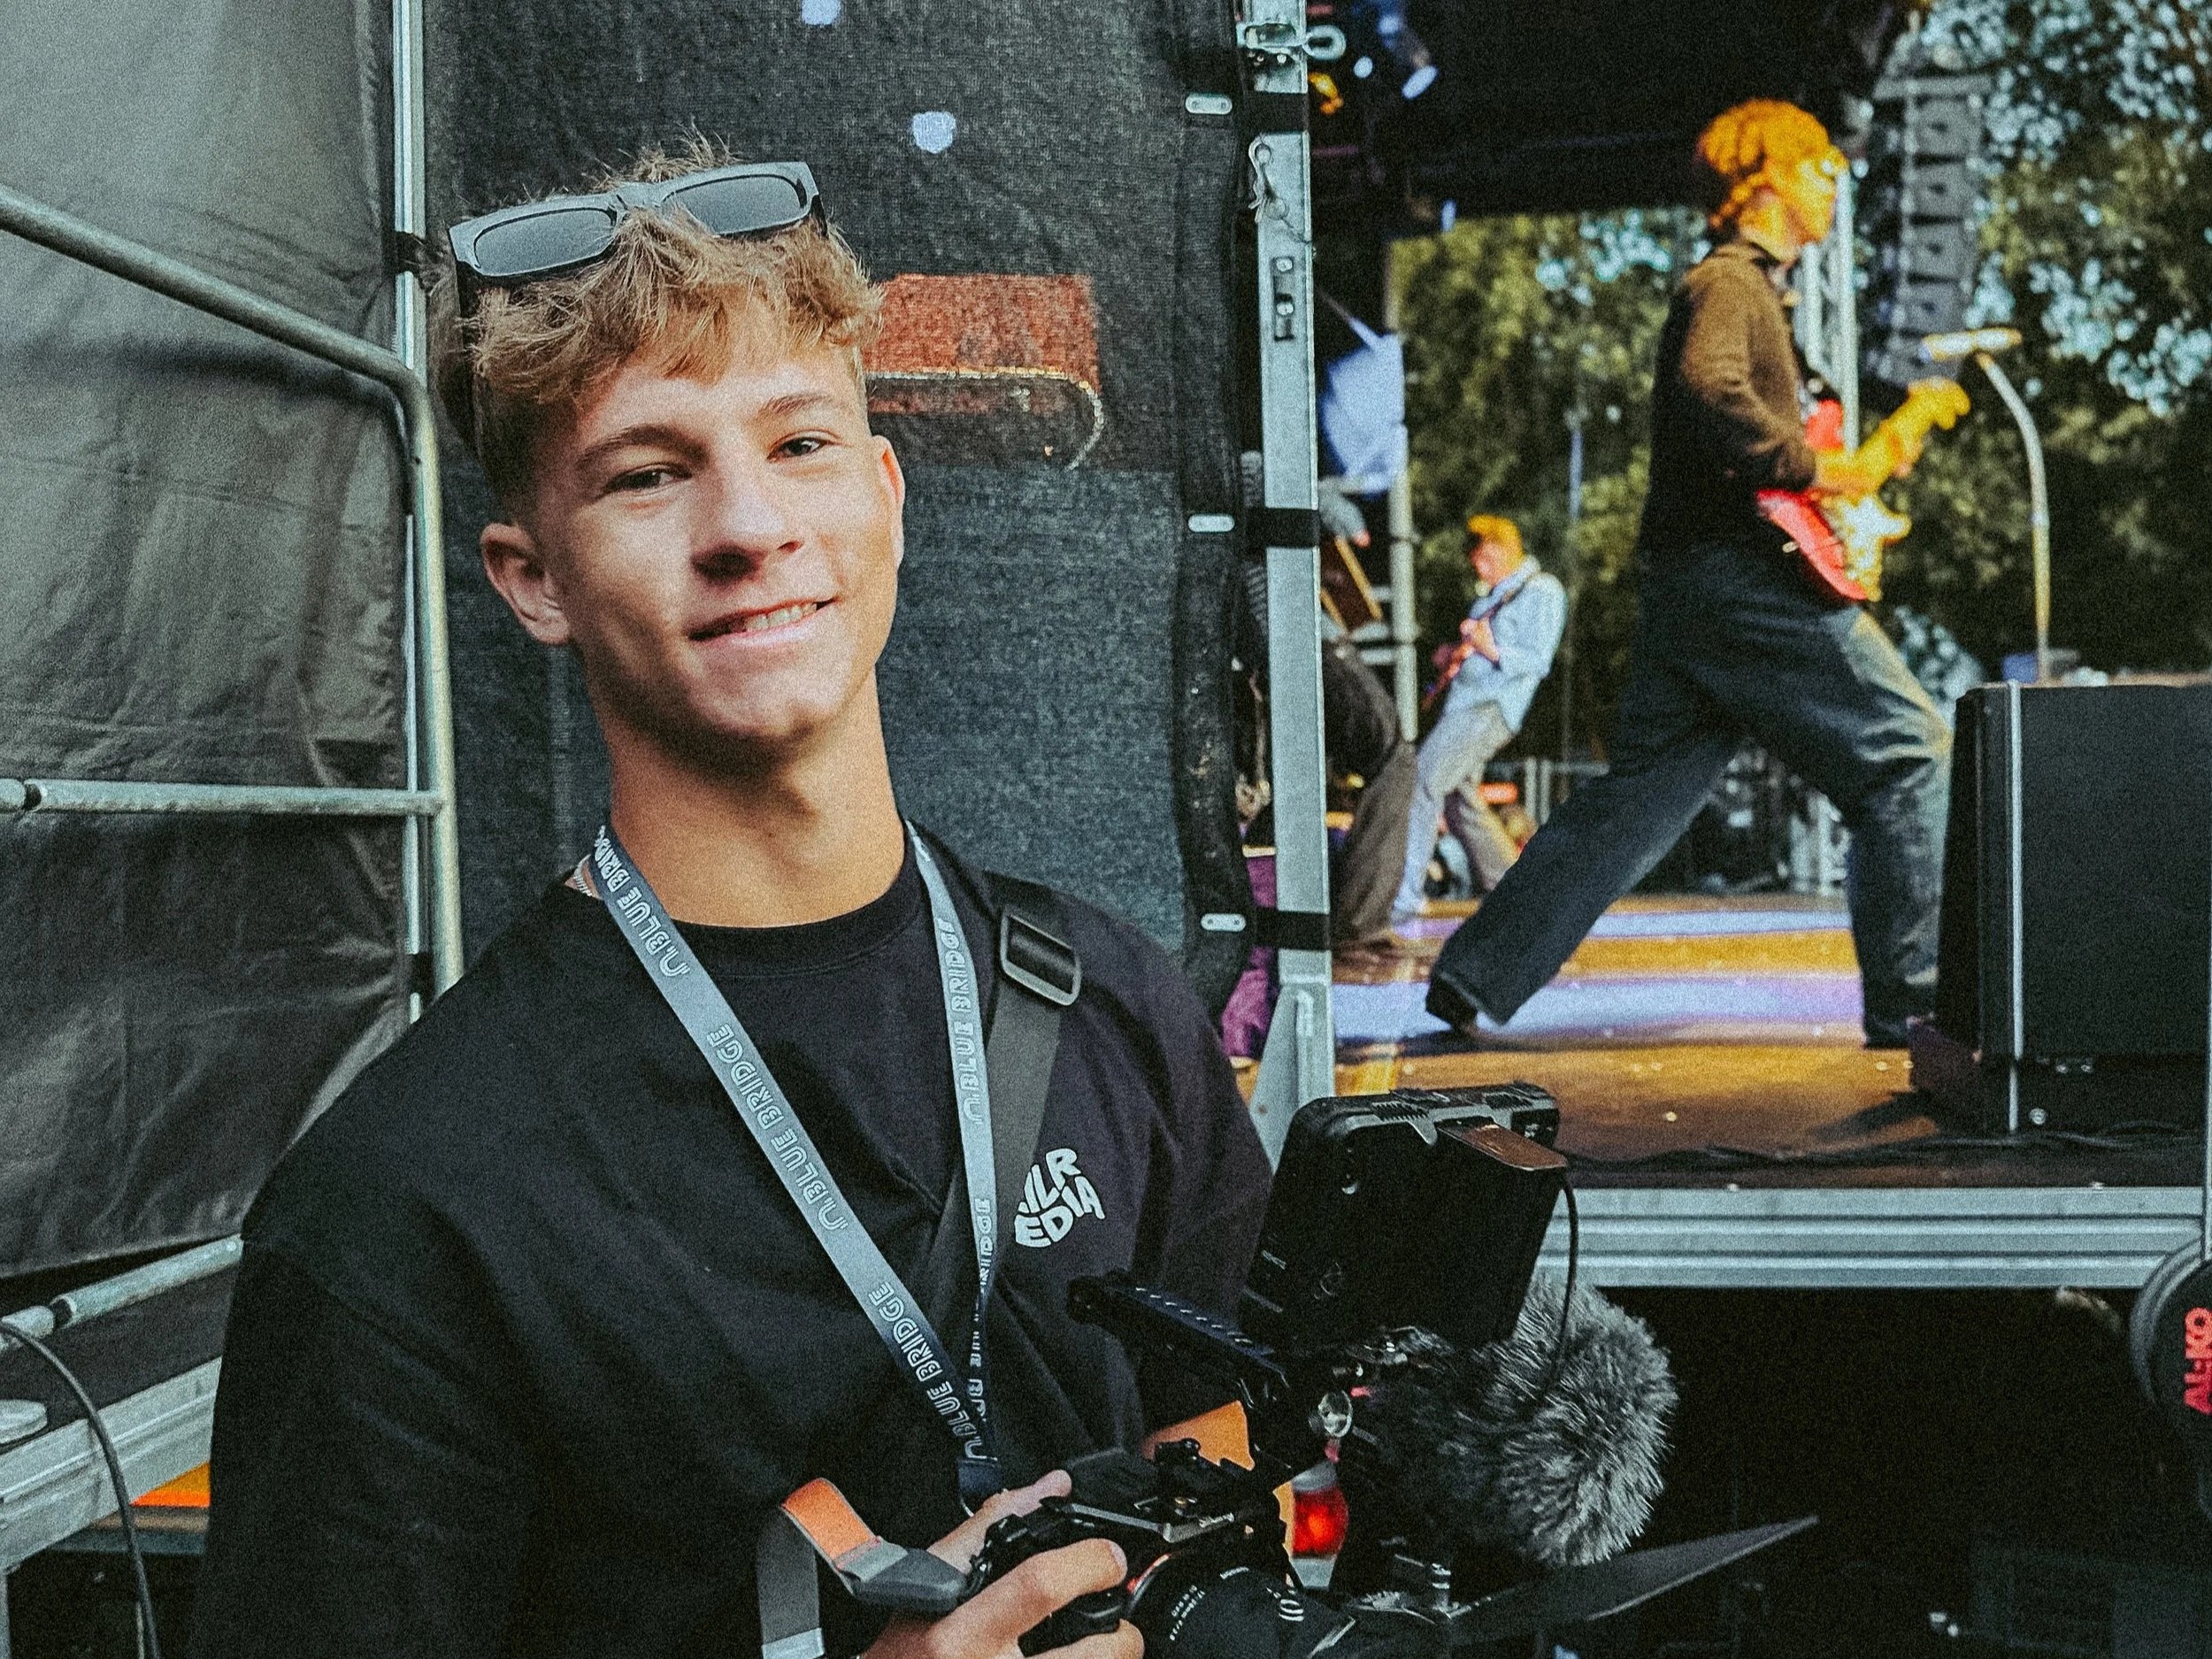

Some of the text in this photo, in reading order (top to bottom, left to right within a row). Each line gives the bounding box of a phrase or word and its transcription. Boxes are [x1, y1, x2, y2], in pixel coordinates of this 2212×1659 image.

[618, 887, 672, 956] BLUE
[954, 1021, 980, 1091] BLUE
[708, 1024, 829, 1204] BLUE BRIDGE
[975, 1198, 994, 1293] RIDGE
[1014, 1176, 1105, 1248] EDIA
[869, 1282, 977, 1437] BLUE BRIDGE
